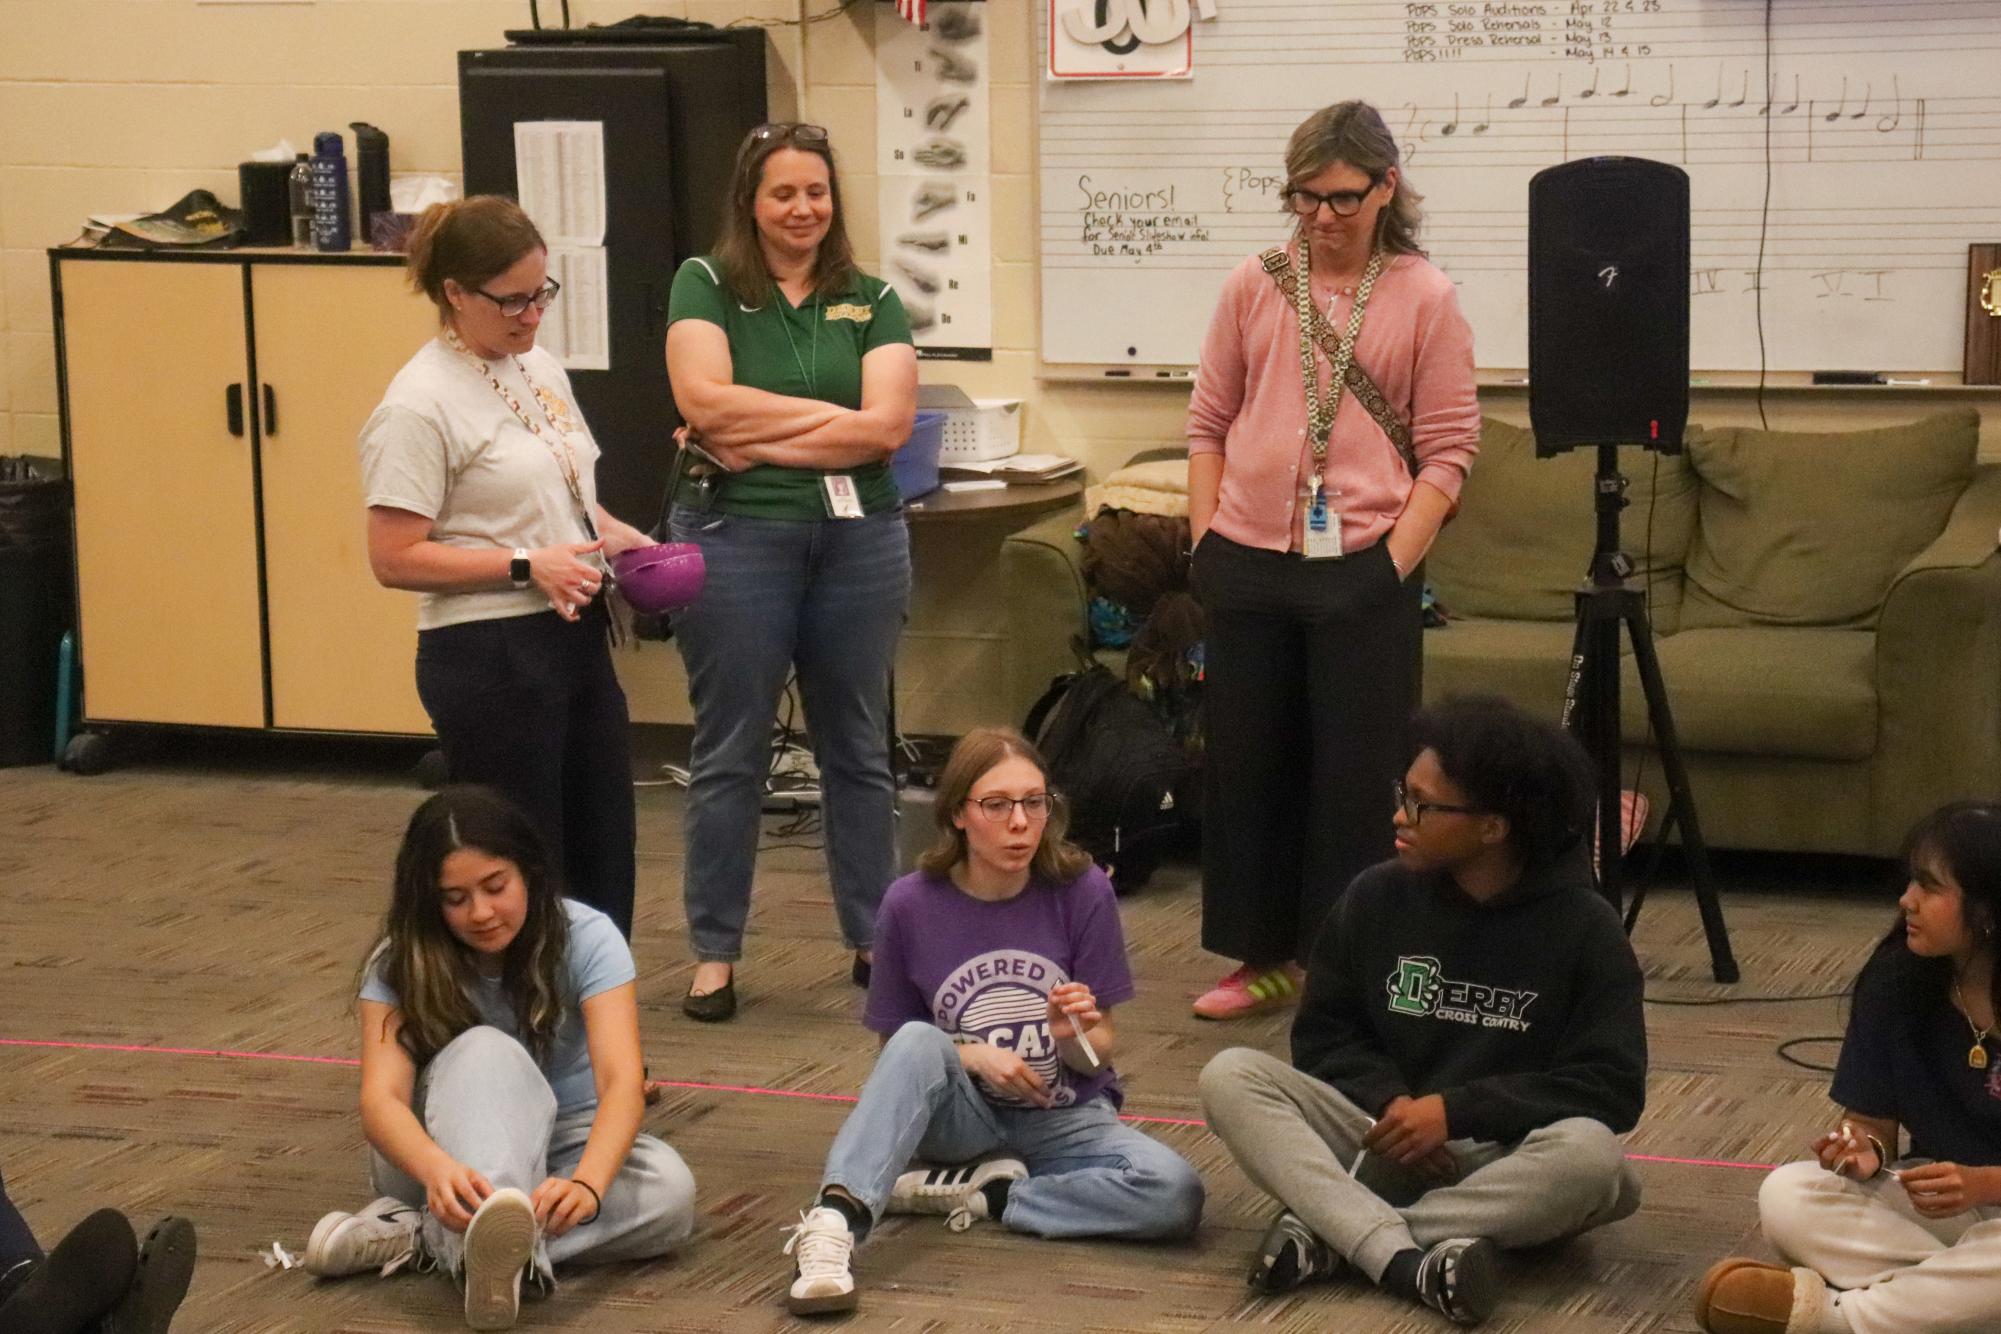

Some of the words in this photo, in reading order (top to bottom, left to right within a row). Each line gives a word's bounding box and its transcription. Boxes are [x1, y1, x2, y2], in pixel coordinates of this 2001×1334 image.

[1447, 4, 1476, 16] Solo
[1484, 2, 1546, 16] Auditions
[1448, 19, 1474, 32] Solo
[1566, 19, 1592, 33] May
[1446, 34, 1483, 46] Dress
[1566, 33, 1592, 48] May
[1566, 47, 1594, 64] May
[966, 191, 975, 202] Fa
[1079, 175, 1175, 212] Seniors!
[1084, 211, 1122, 229] Check
[1130, 216, 1158, 233] your
[1163, 214, 1198, 227] email
[1082, 225, 1101, 243] for
[1093, 243, 1114, 255] Due
[1120, 244, 1142, 256] May
[938, 958, 1046, 1023] POWERED
[1387, 956, 1538, 1020] DERBY
[1435, 1008, 1478, 1025] CROSS
[1482, 1016, 1532, 1033] CONTRY
